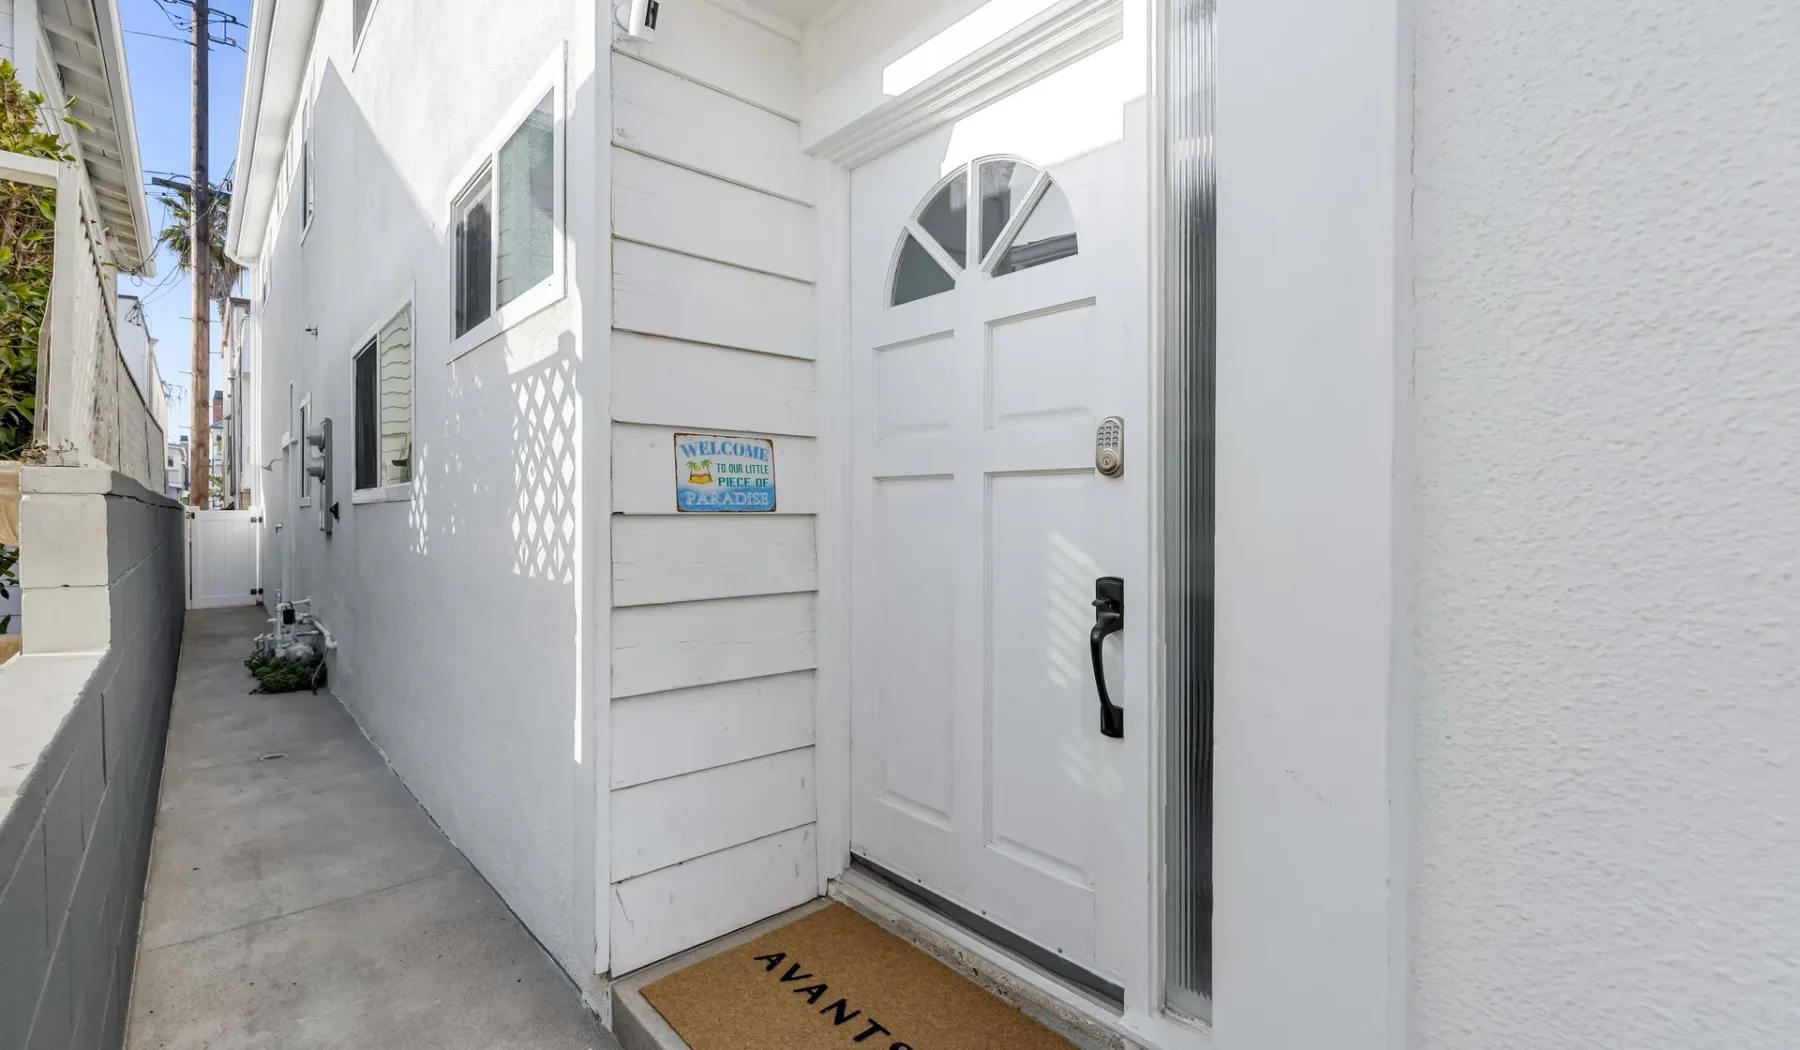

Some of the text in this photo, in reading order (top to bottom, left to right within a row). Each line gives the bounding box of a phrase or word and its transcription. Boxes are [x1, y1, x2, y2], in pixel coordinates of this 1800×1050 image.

[679, 440, 769, 462] WELCOME
[716, 462, 769, 475] TO OUR LITTLE
[718, 477, 769, 488] PIECE OF
[684, 491, 769, 506] PARADISE
